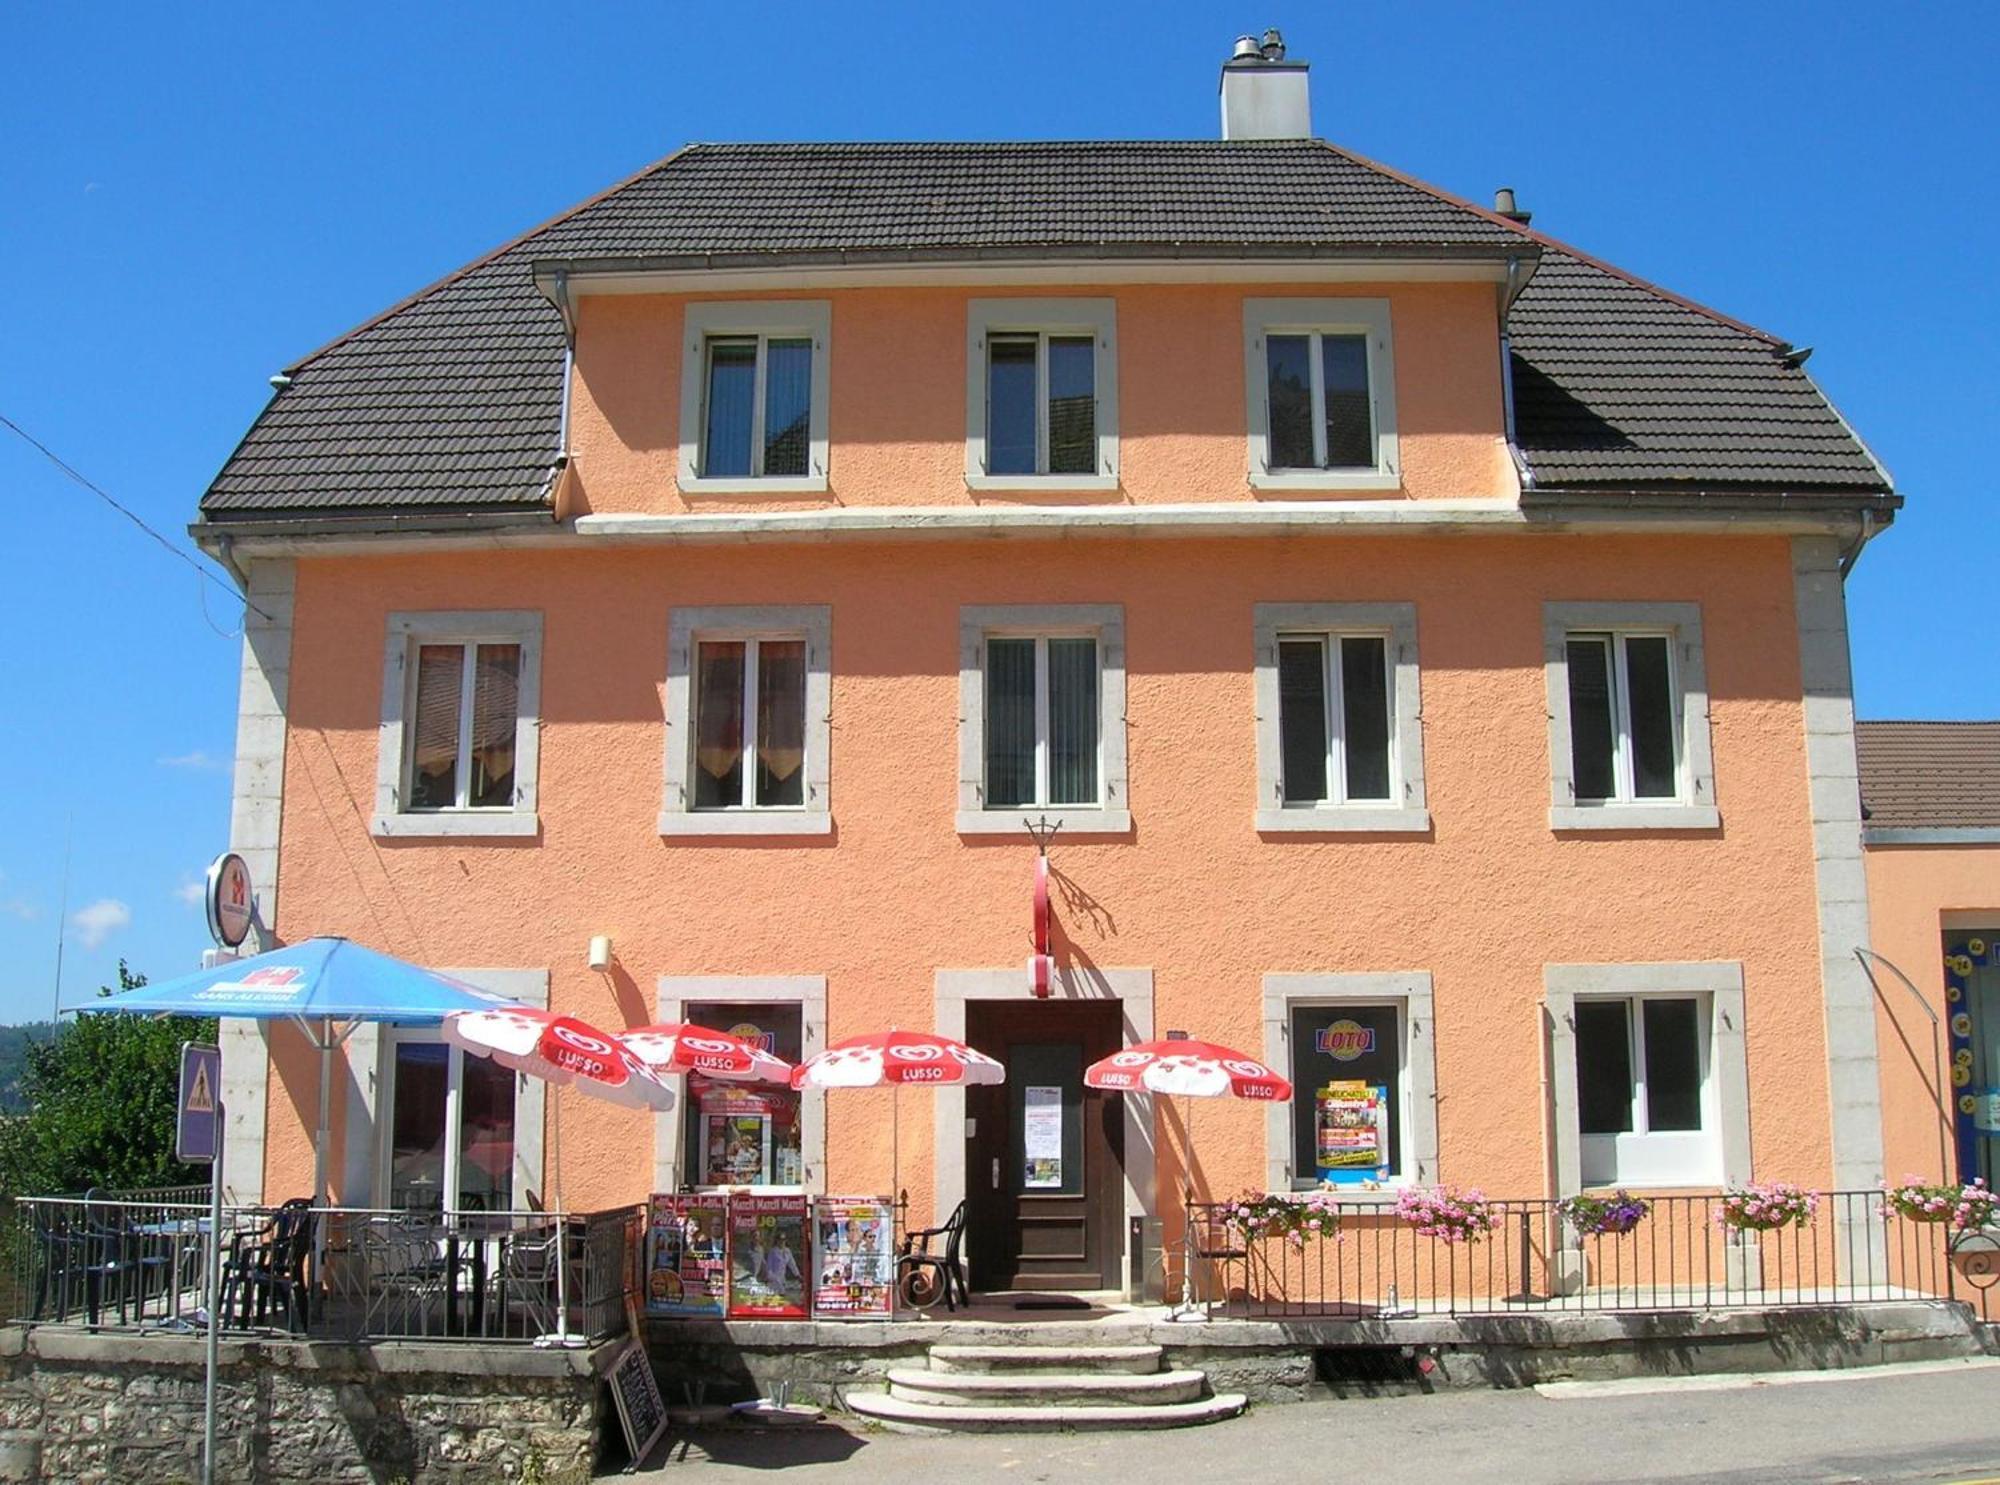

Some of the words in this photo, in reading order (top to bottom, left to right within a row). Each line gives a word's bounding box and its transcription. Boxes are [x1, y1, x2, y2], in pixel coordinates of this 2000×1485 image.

[1318, 1031, 1370, 1050] LOTO
[558, 1049, 604, 1074] LUSSO
[694, 1055, 734, 1070] LUSSO
[902, 1067, 943, 1081] LUSSO
[1100, 1072, 1131, 1085] LUSSO
[1242, 1084, 1273, 1098] LUSSO
